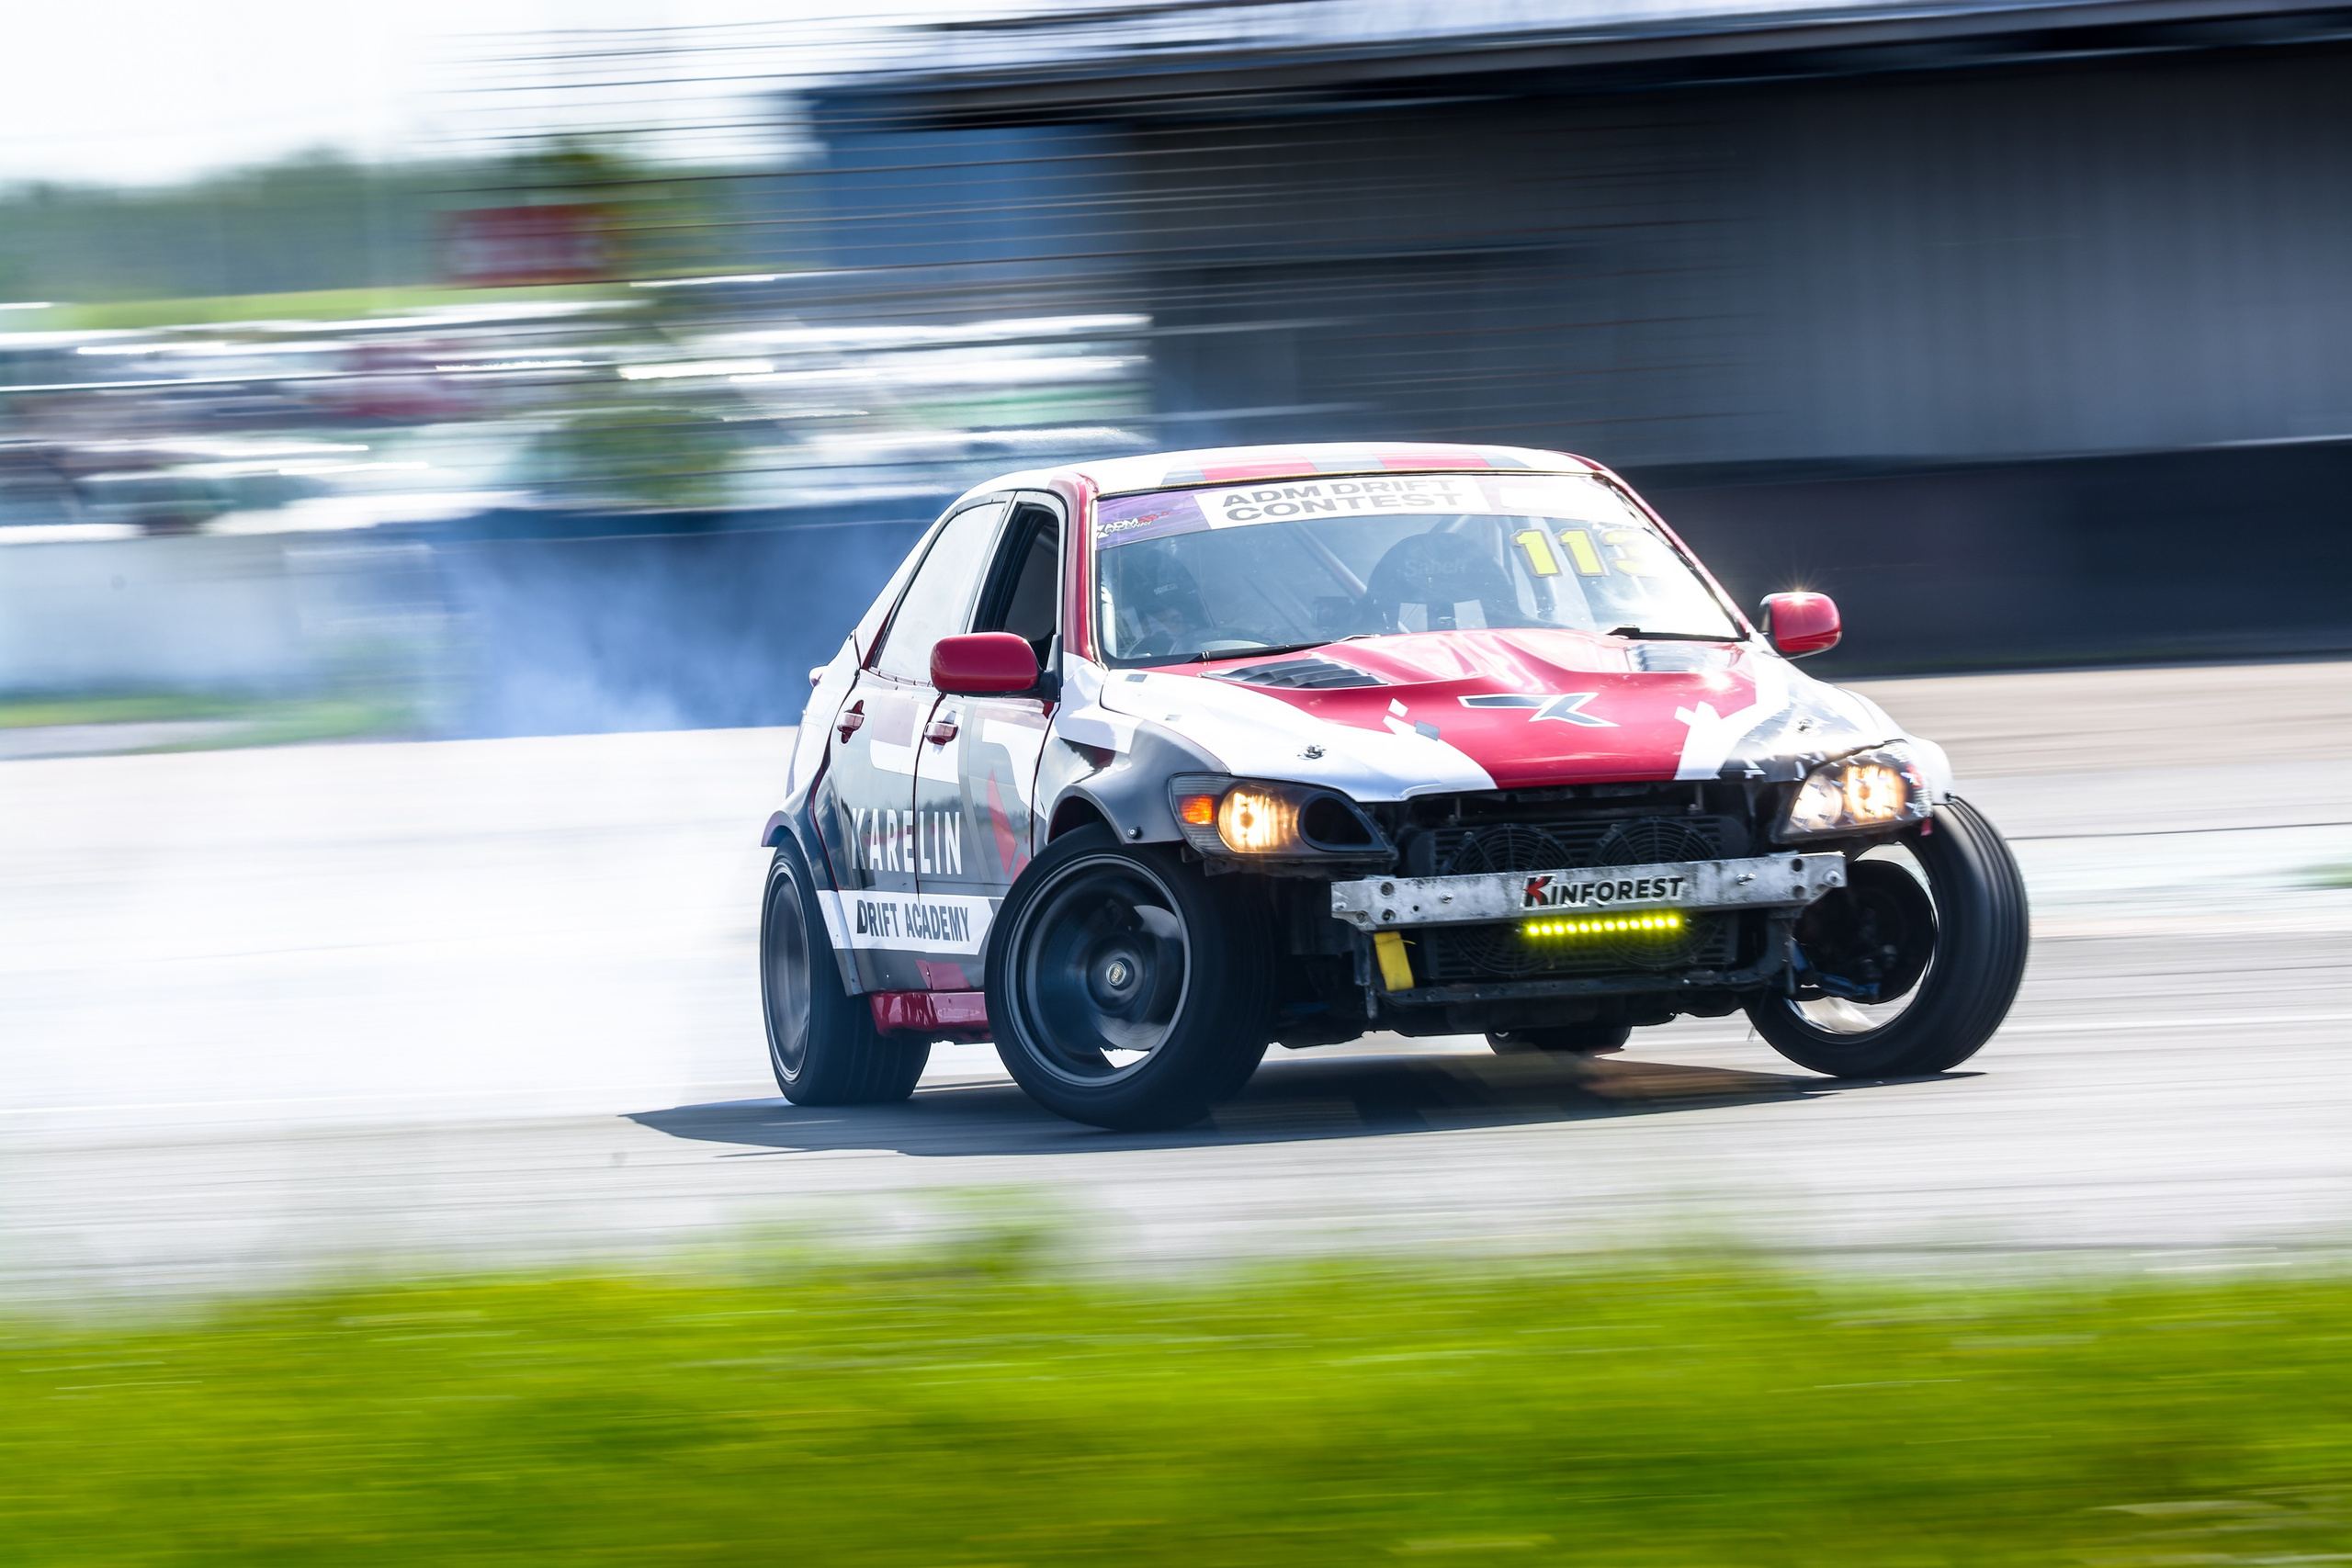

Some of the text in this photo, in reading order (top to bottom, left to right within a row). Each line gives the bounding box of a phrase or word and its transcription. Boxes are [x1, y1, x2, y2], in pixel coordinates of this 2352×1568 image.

[1222, 479, 1457, 508] ADM DRIFT
[1226, 493, 1463, 521] CONTEST
[851, 807, 963, 874] KARELIN
[1522, 874, 1685, 908] KINFOREST
[856, 899, 970, 942] DRIFT ACADEMY
